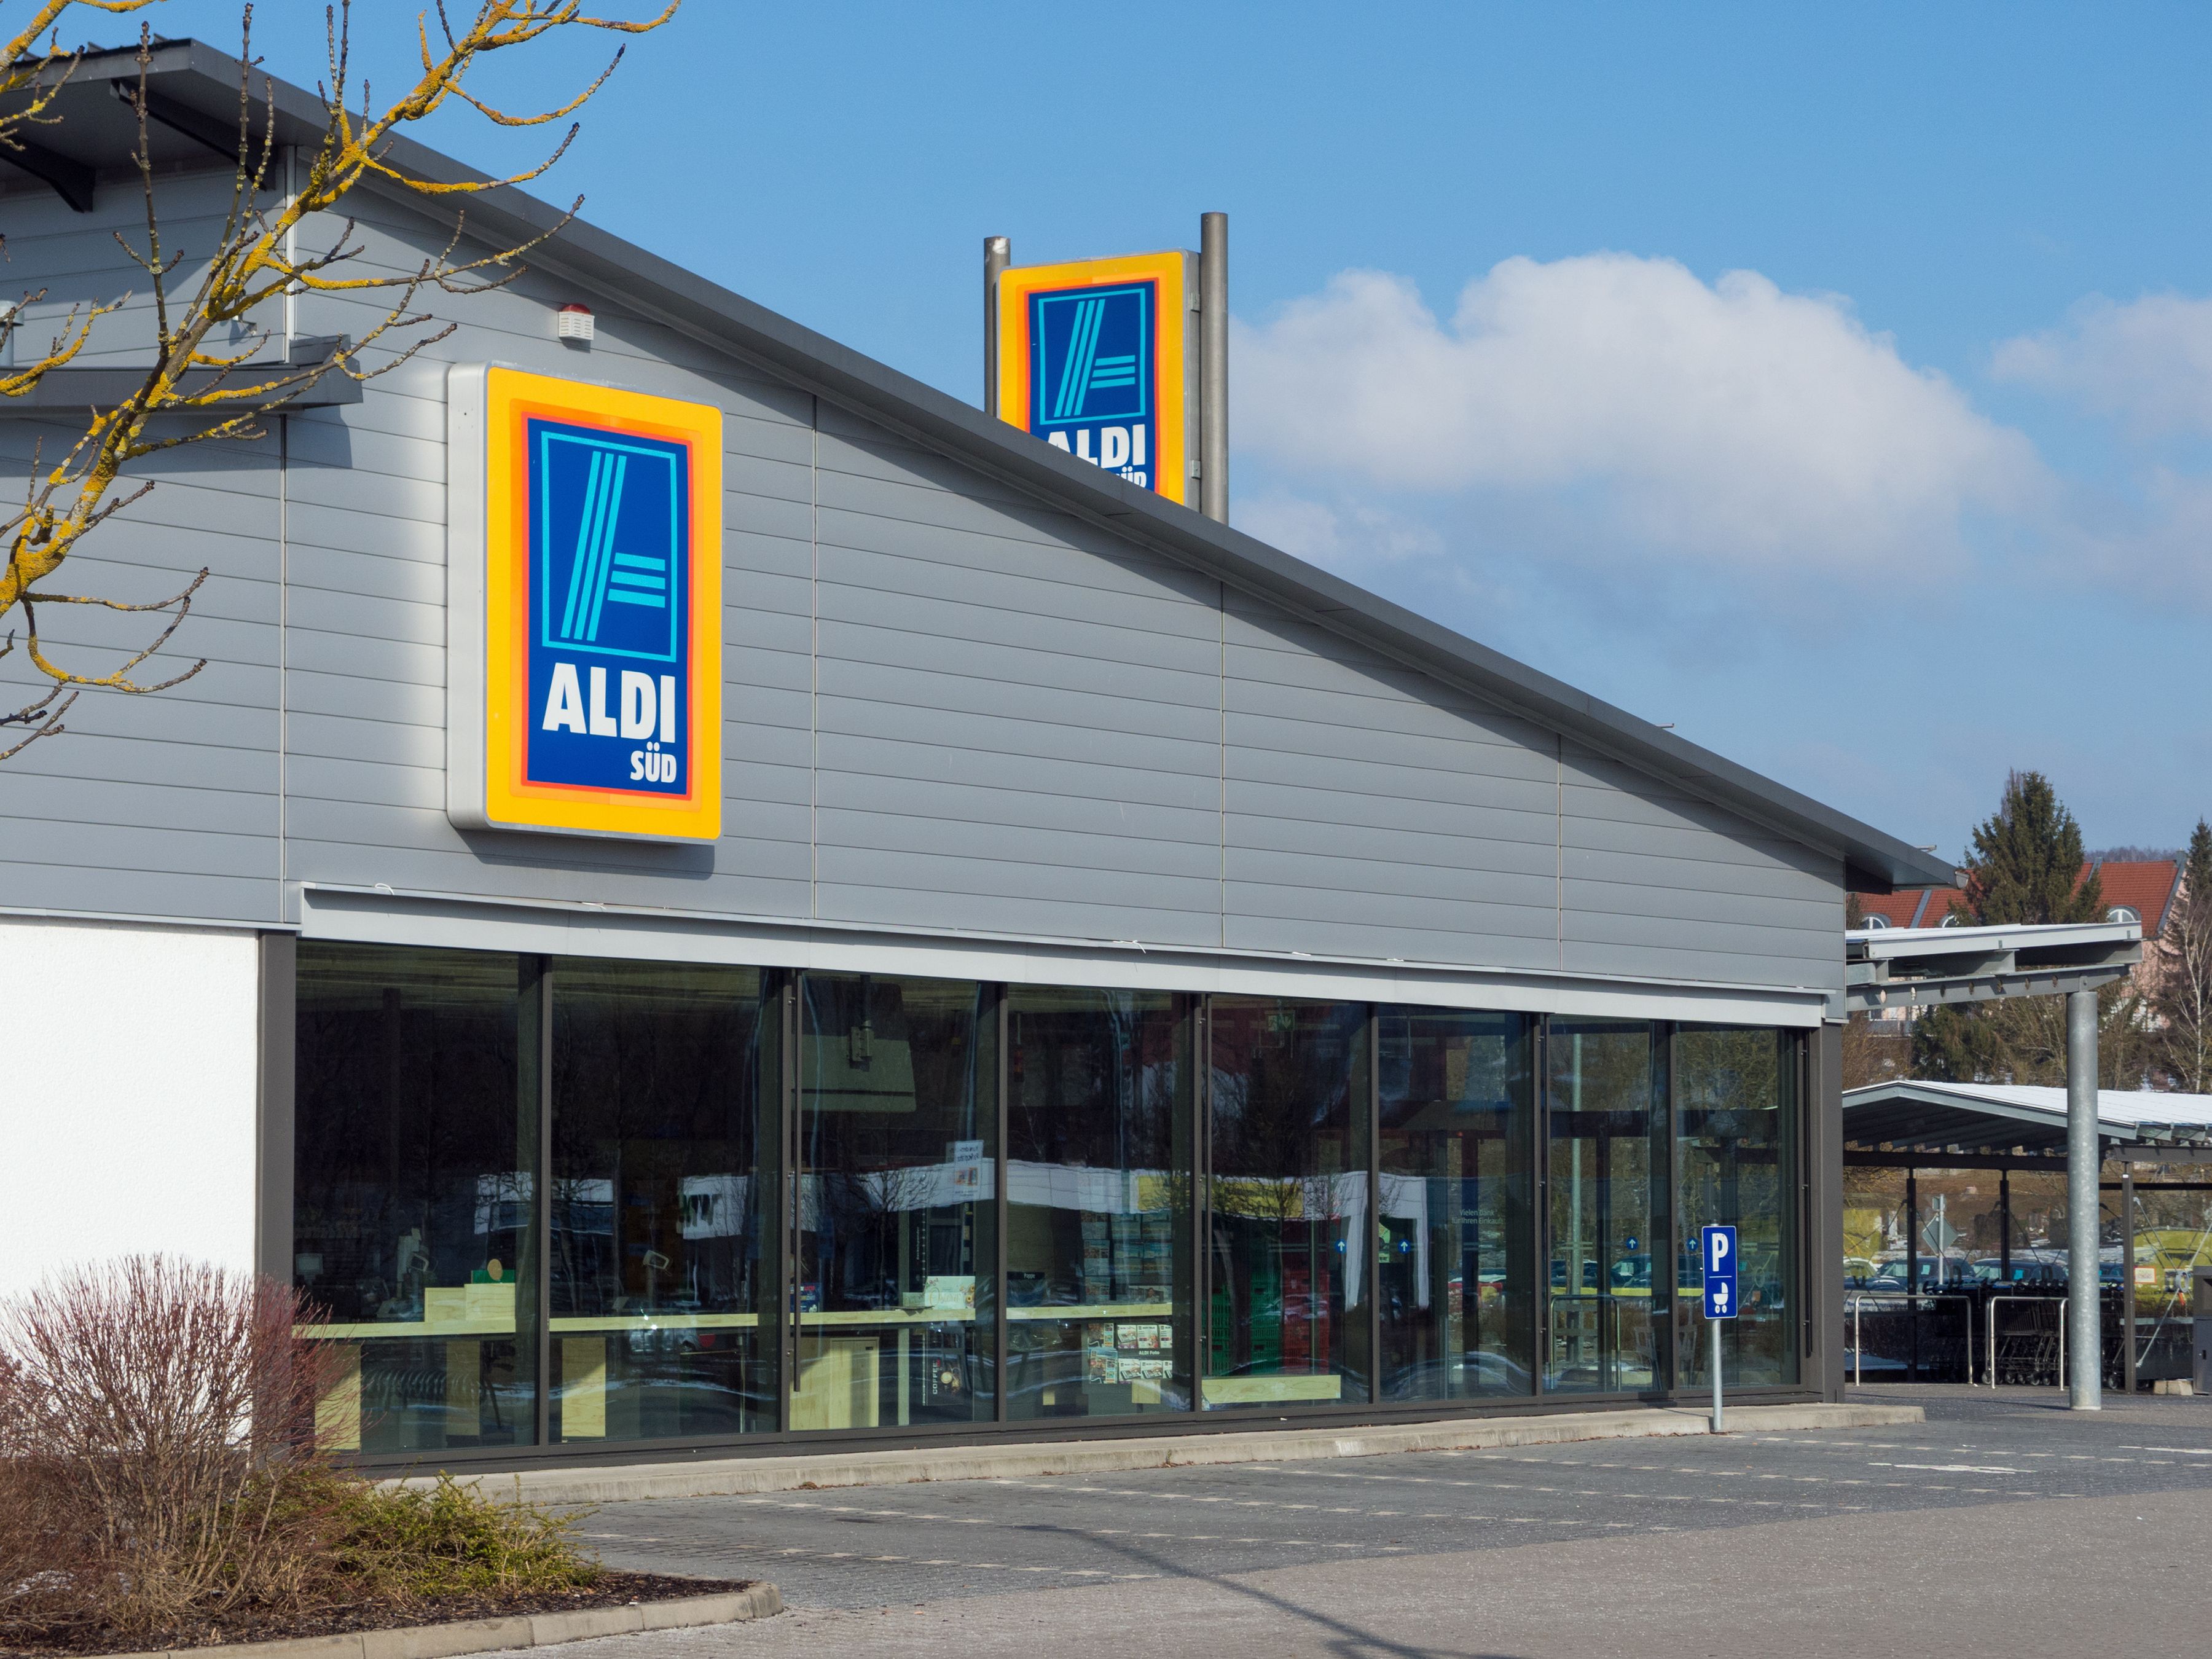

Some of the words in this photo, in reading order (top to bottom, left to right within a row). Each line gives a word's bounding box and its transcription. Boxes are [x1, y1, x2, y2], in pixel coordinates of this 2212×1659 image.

[542, 662, 675, 743] ALDI
[630, 741, 677, 783] SÜD
[1712, 1233, 1728, 1272] P
